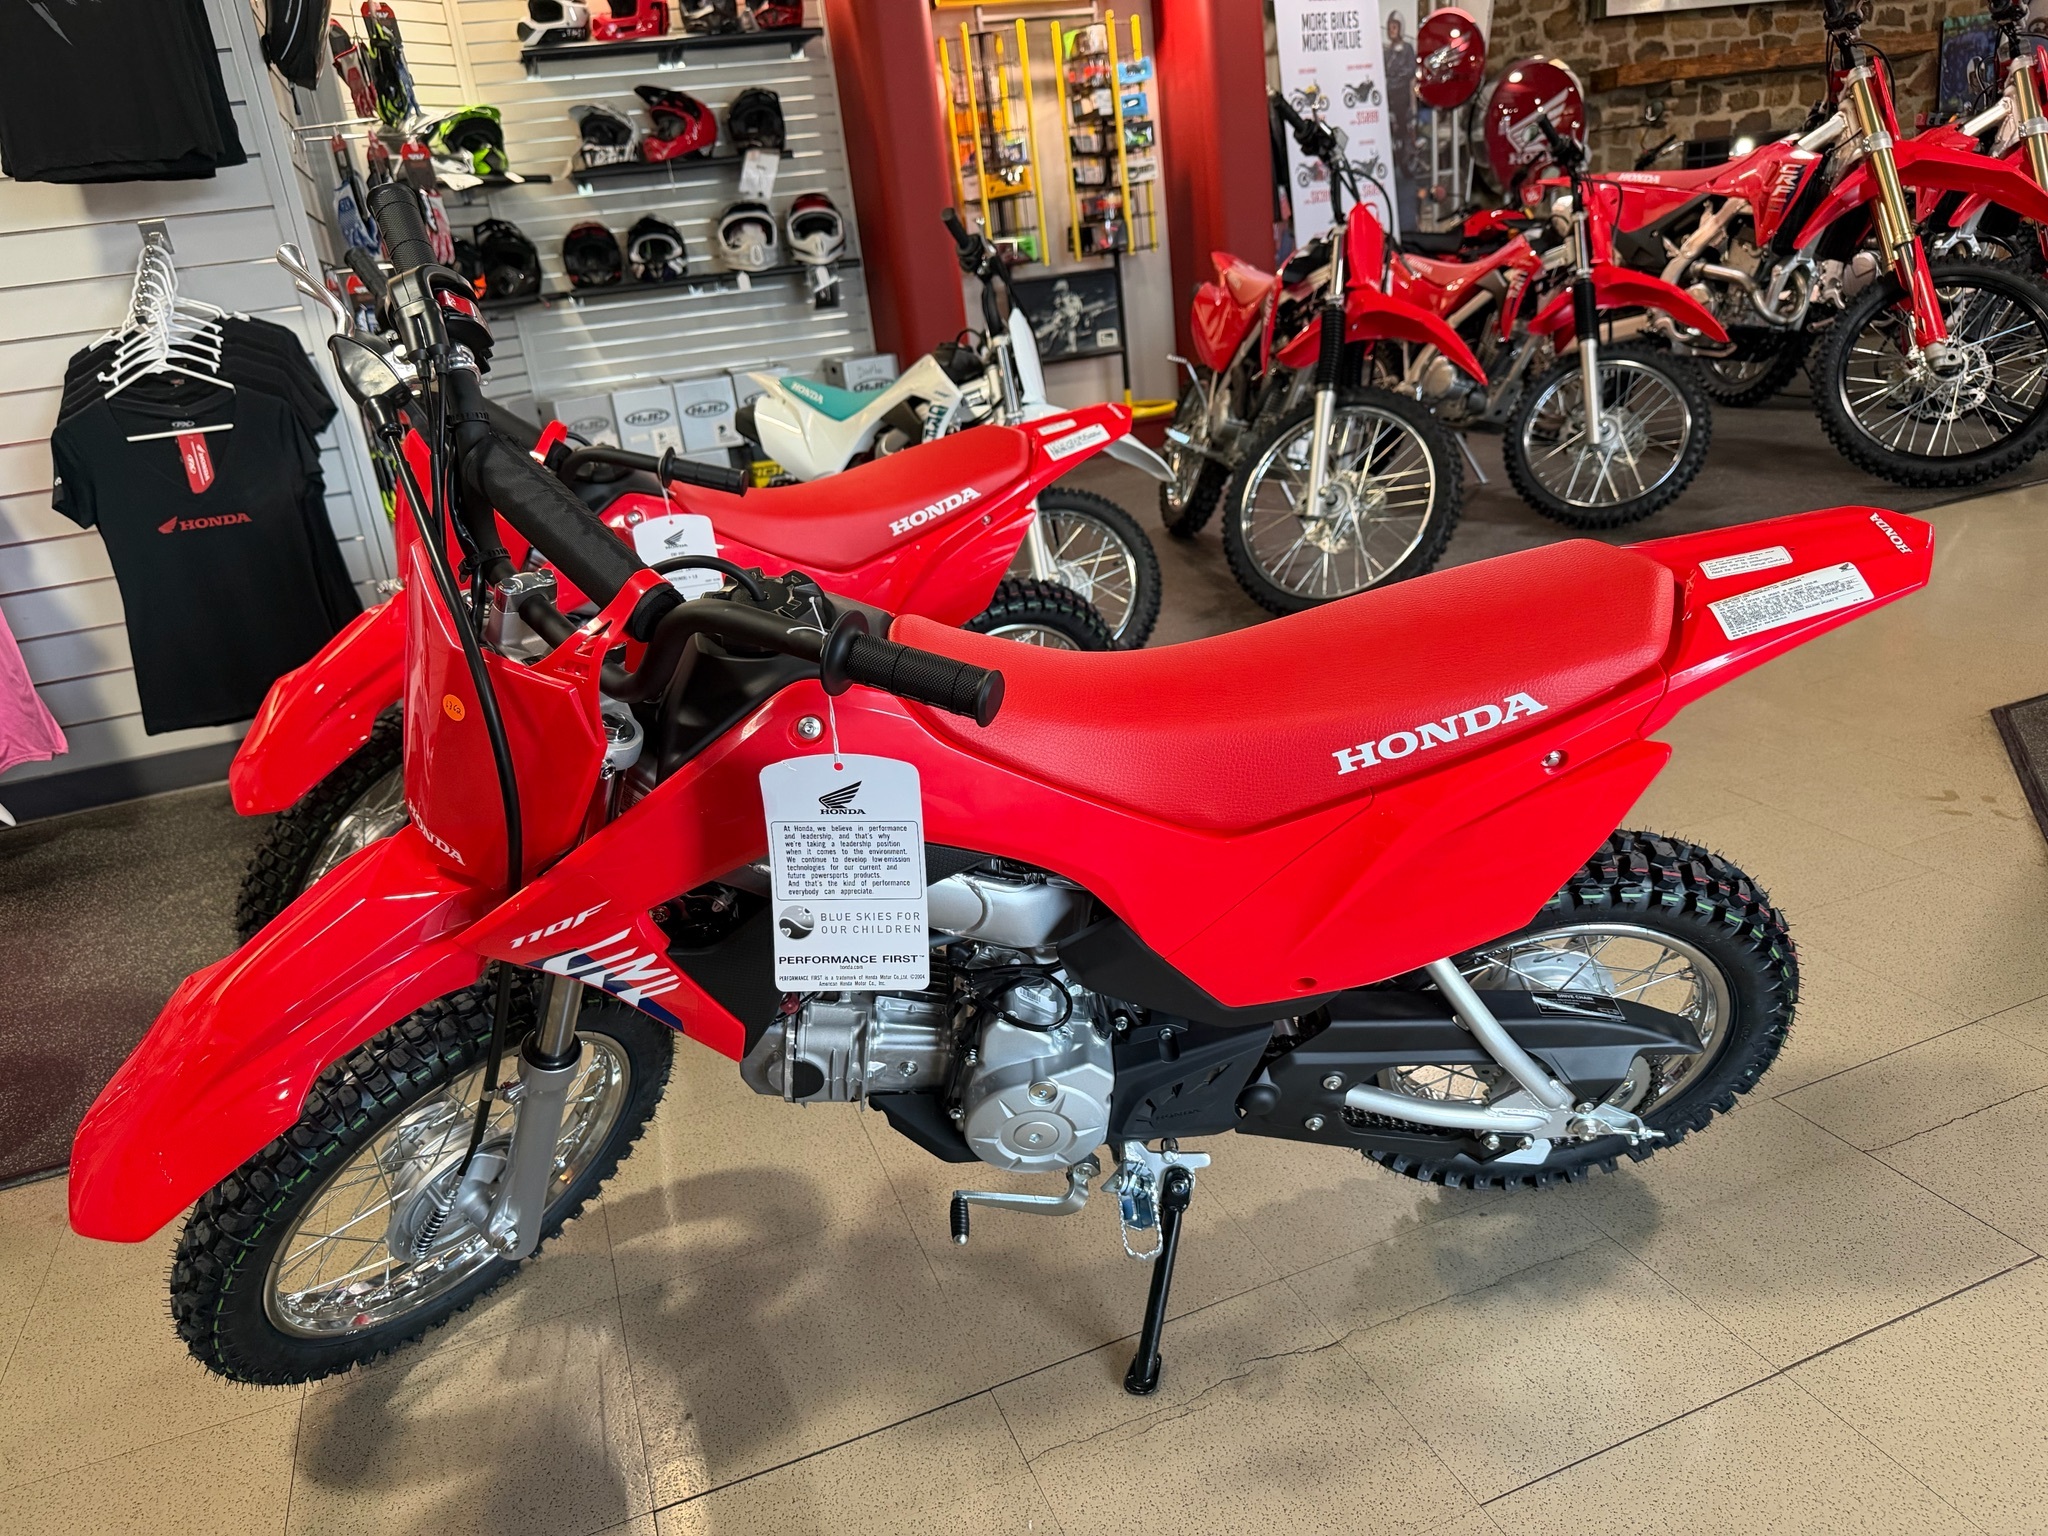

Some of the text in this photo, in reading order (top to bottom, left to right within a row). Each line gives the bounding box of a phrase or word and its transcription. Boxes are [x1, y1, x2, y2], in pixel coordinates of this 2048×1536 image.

[1302, 10, 1359, 31] MORE BIKES
[1302, 30, 1362, 52] MORE VALUE
[1617, 172, 1660, 184] HONDA
[791, 382, 823, 404] HONDA
[180, 512, 252, 531] HONDA
[889, 487, 981, 536] HONDA
[1870, 512, 1912, 554] HONDA
[1332, 692, 1548, 775] HONDA
[408, 797, 466, 866] HONDA
[510, 900, 612, 949] 110F
[821, 912, 920, 921] BLUE SKIES FOR
[821, 925, 920, 934] OUR CHILDREN
[779, 955, 877, 964] PERFORMANCE
